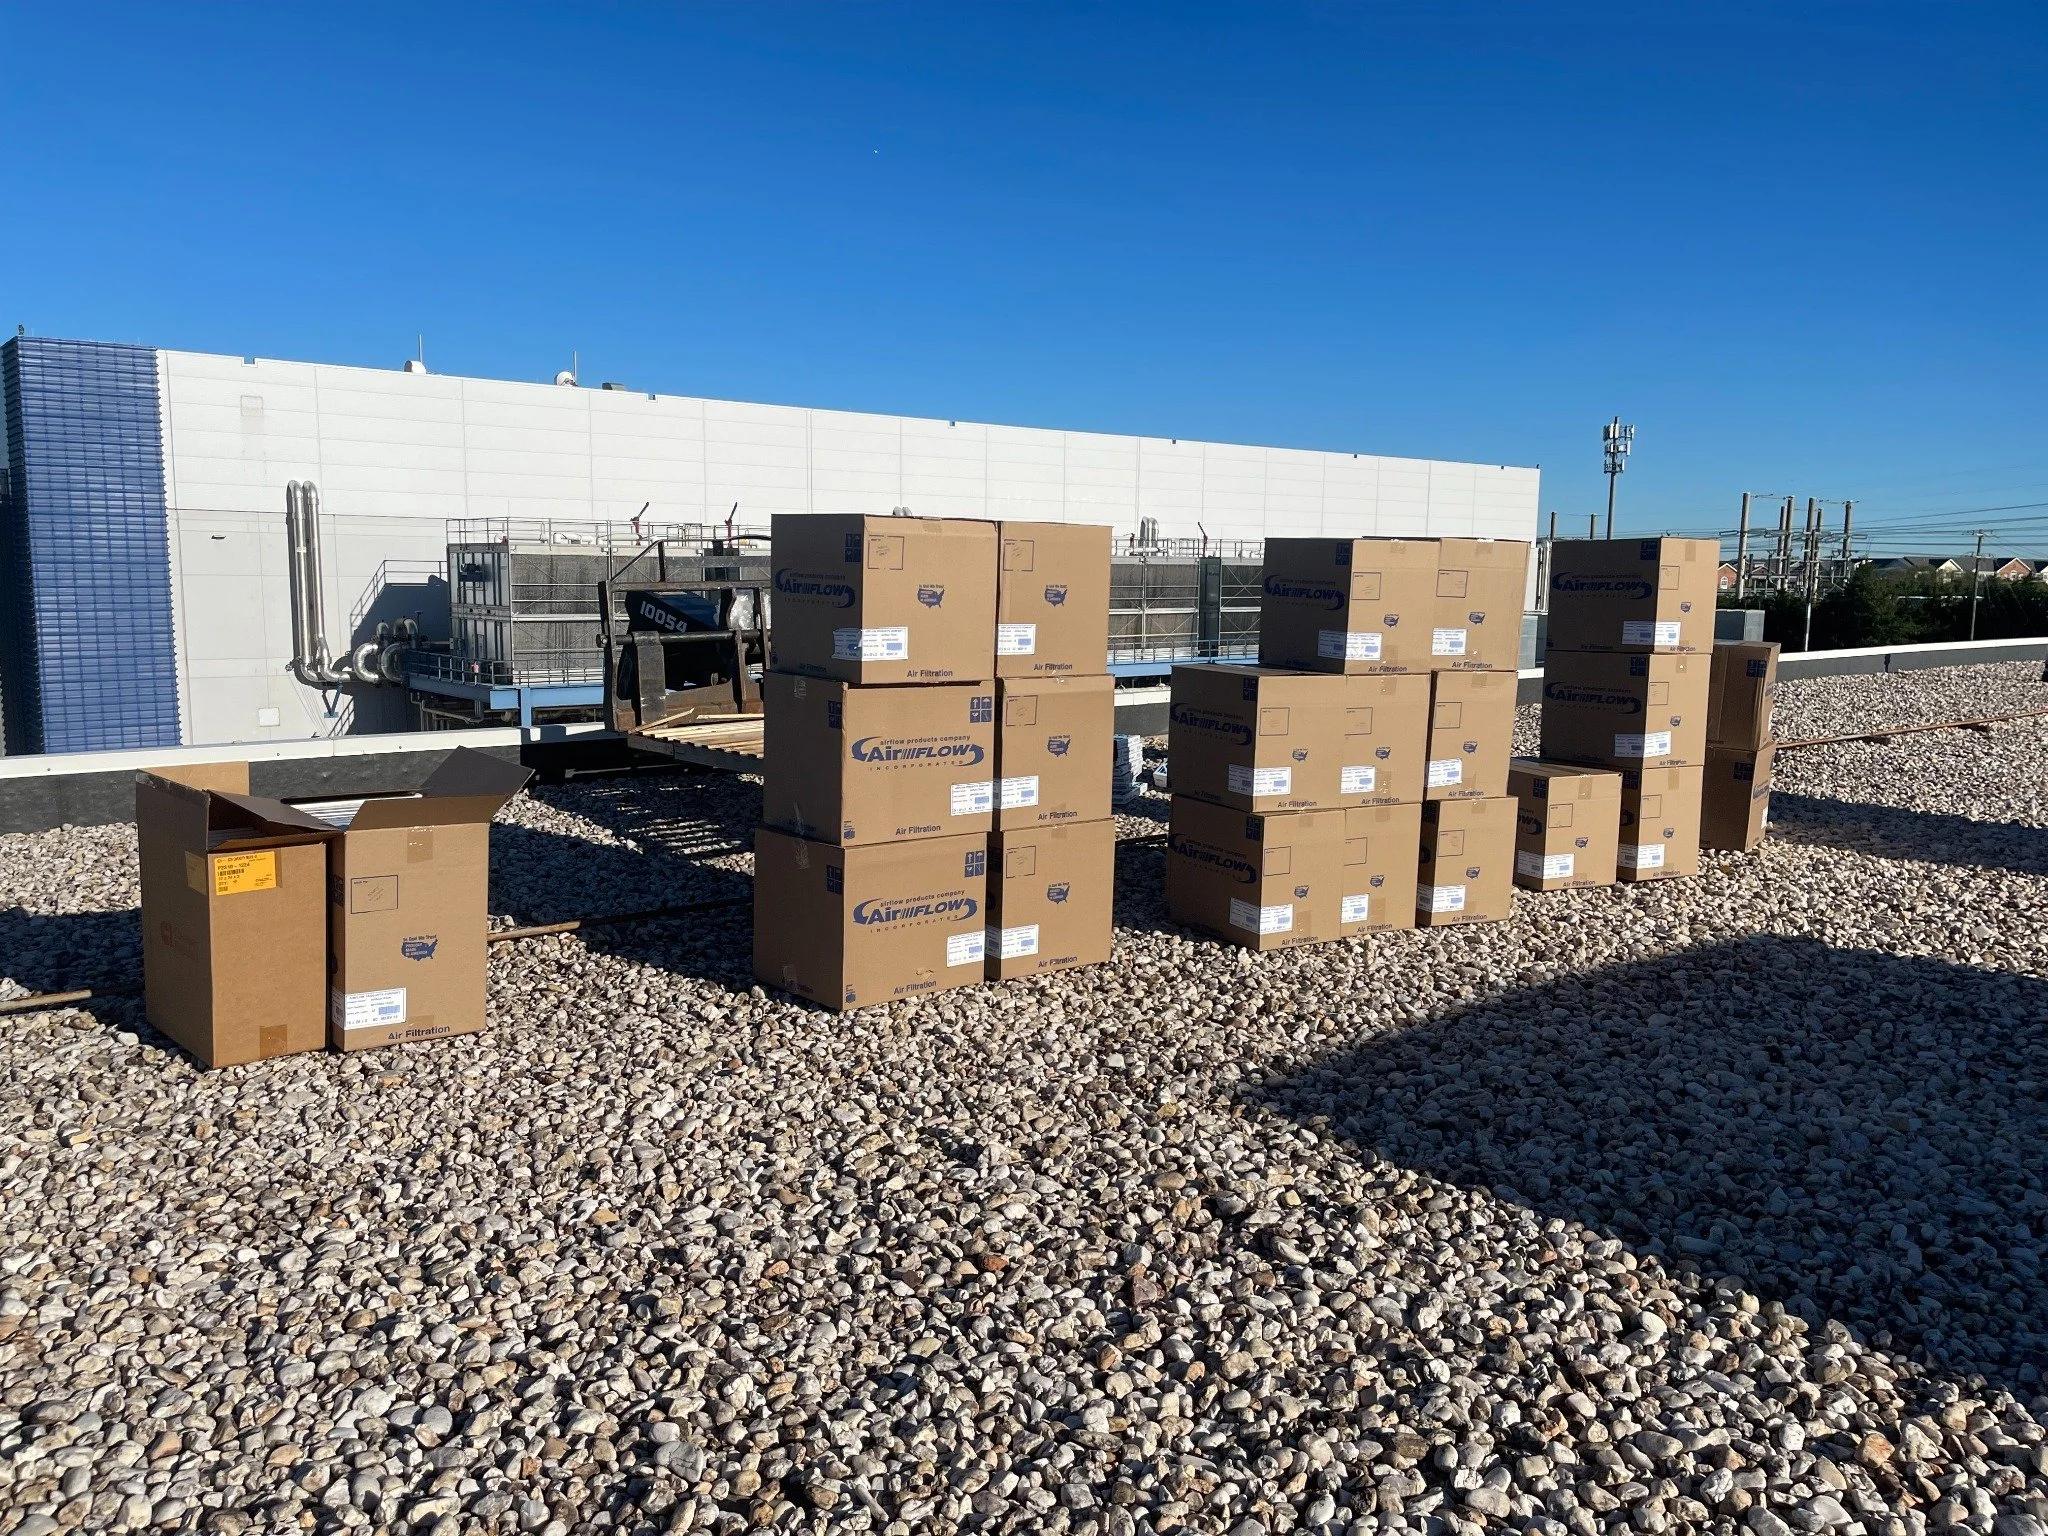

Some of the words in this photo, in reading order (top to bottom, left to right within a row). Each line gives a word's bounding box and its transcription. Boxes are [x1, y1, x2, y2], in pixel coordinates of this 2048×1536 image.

[640, 601, 687, 633] 10054
[1045, 662, 1073, 670] Filtration
[1463, 661, 1493, 669] Filtration
[907, 669, 918, 678] Air
[920, 669, 953, 678] Filtration
[907, 737, 938, 746] products
[870, 760, 964, 771] INCORPORATED
[1037, 812, 1047, 820] Air
[1050, 811, 1078, 820] Filtration
[895, 826, 906, 835] Air
[908, 825, 941, 835] Filtration
[1572, 879, 1596, 887] Filtration
[880, 899, 903, 907] airflow
[905, 894, 935, 904] products
[937, 889, 965, 898] company
[870, 915, 958, 933] INCORPORATED
[1367, 923, 1392, 931] Filtration
[1281, 938, 1290, 946] Air
[1291, 935, 1319, 944] Filtration
[1038, 960, 1047, 968] Air
[1050, 956, 1078, 966] Filtration
[894, 986, 905, 995] Air
[906, 980, 937, 992] Filtration
[388, 1031, 403, 1040] Air
[405, 1025, 451, 1038] Filtration
